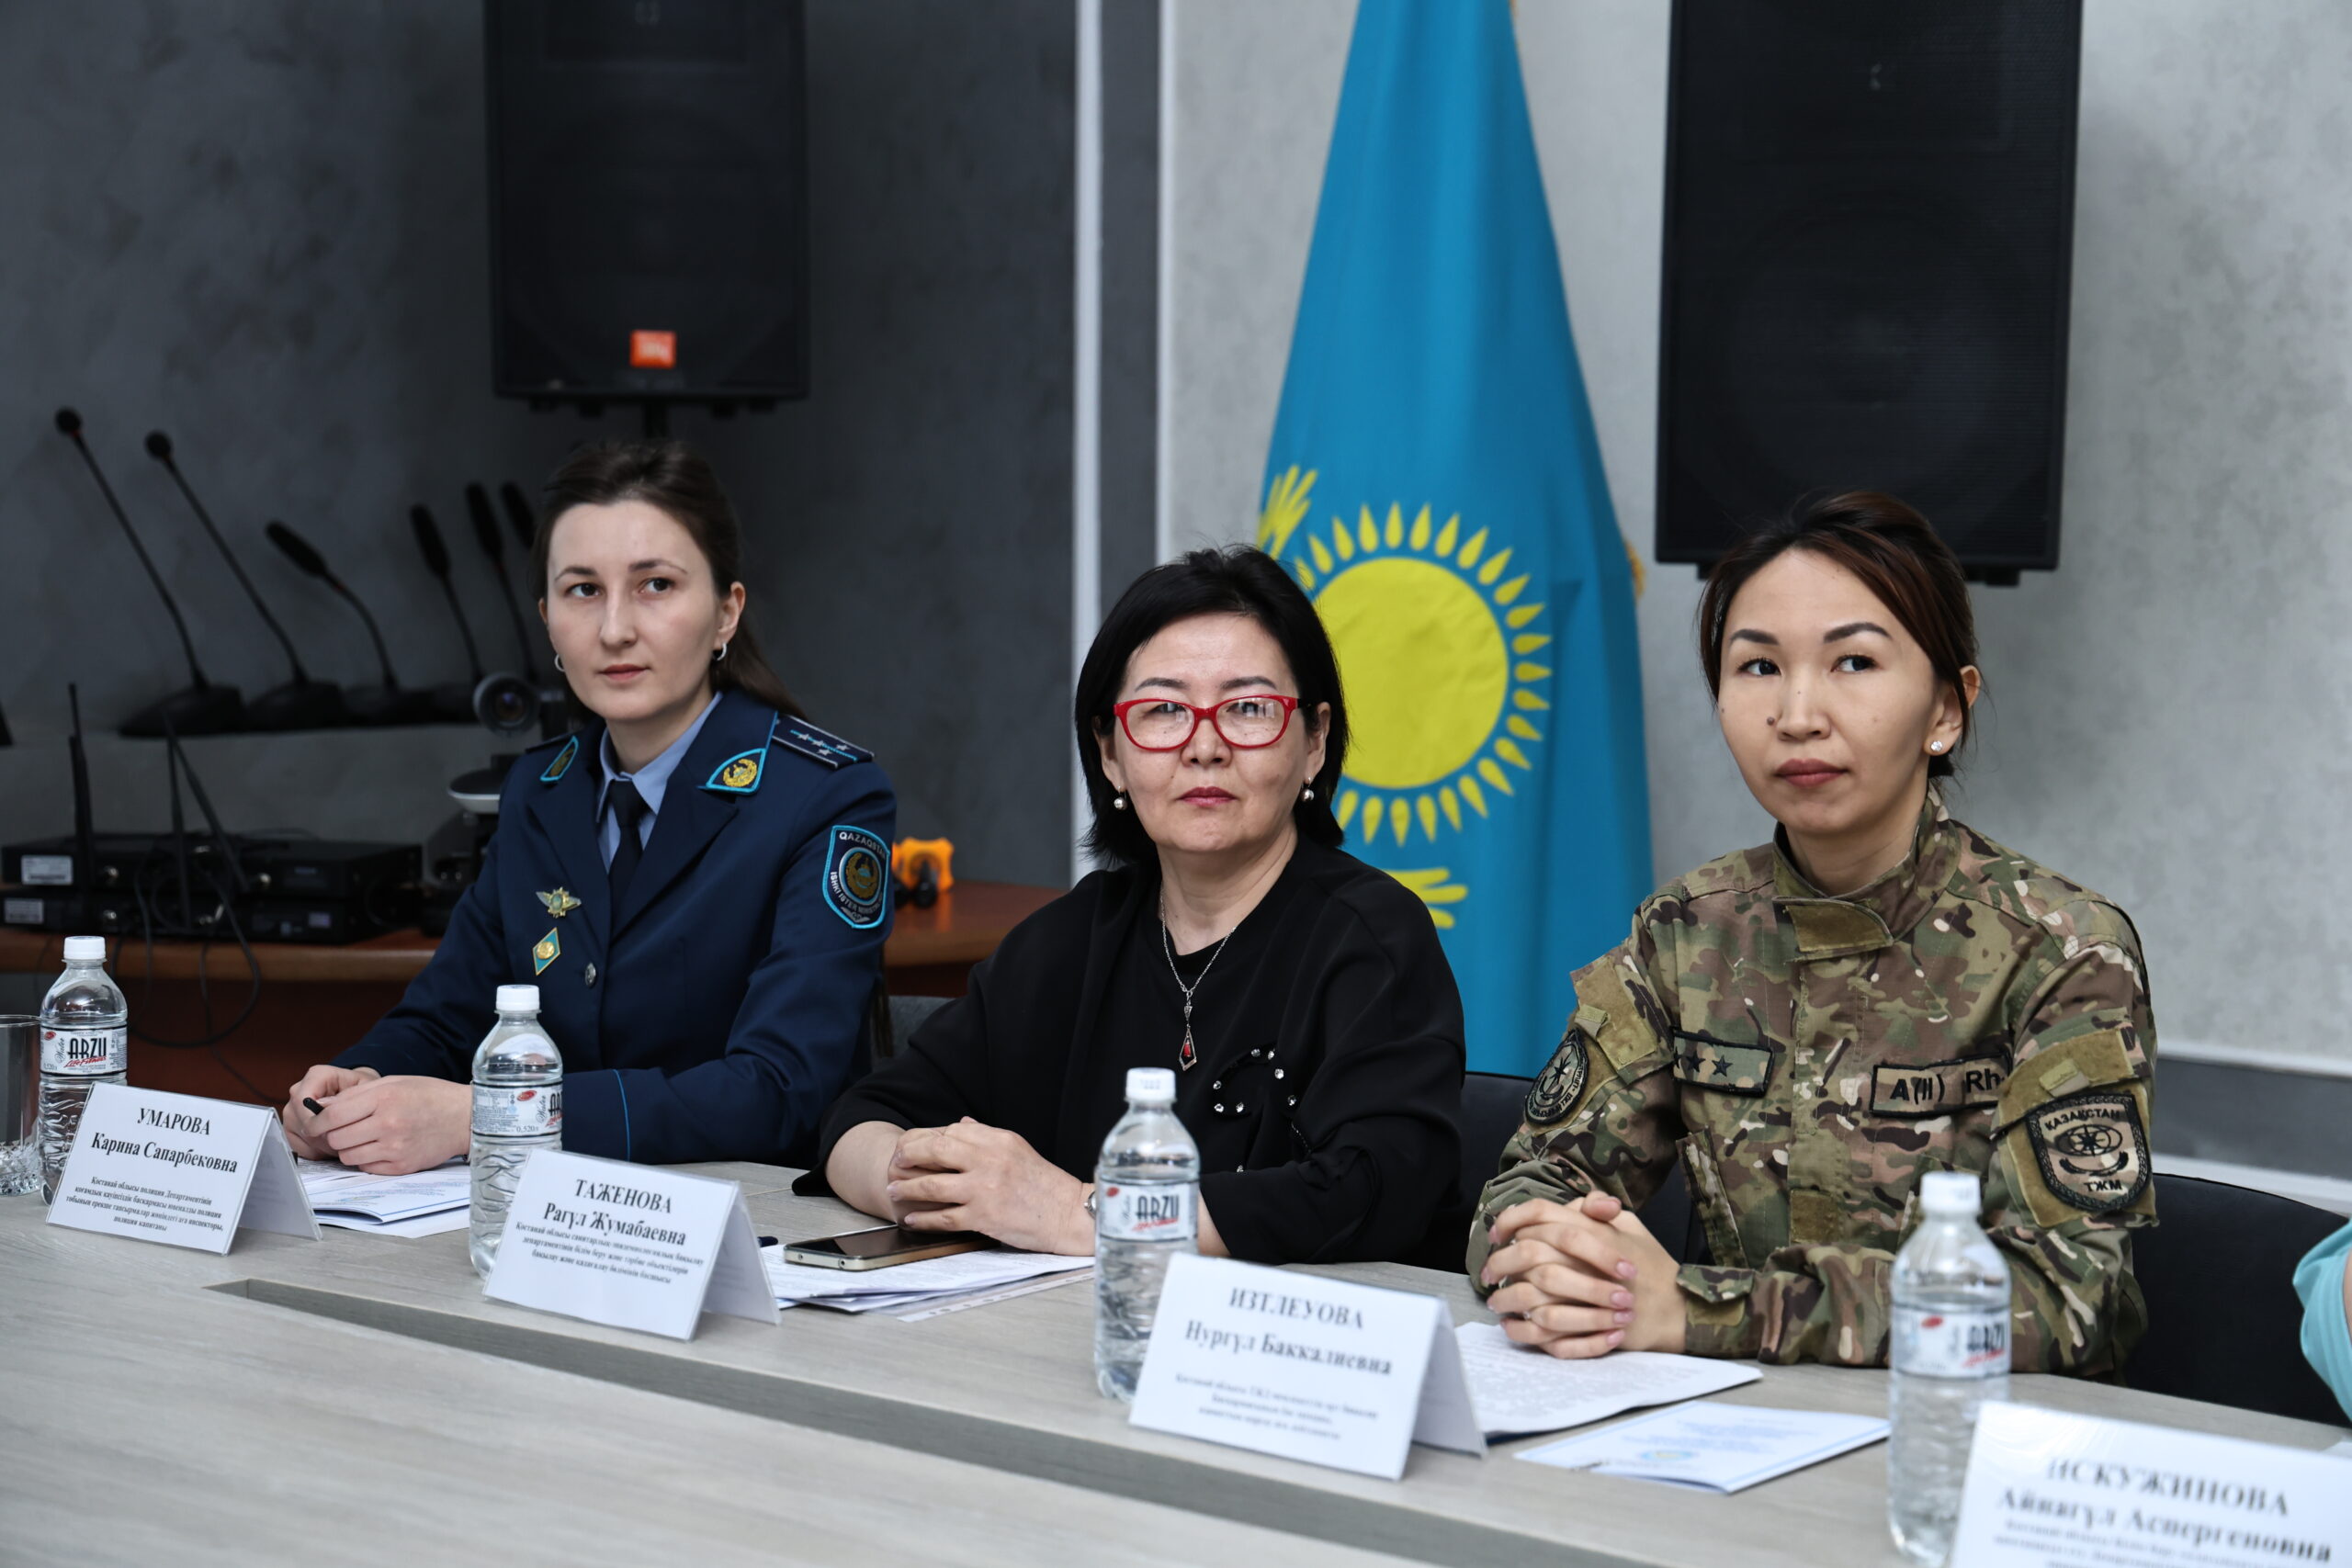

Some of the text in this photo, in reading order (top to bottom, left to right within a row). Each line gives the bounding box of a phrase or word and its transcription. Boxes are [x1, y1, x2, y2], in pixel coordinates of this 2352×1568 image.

[67, 1037, 107, 1059] ARZU
[137, 1107, 210, 1136] УМАРОВА
[91, 1132, 239, 1174] Карина Сапарбековна
[575, 1179, 672, 1213] ТАЖЕНОВА
[2083, 1179, 2122, 1192] ТЖМ
[589, 1211, 687, 1247] Жумабаевна
[1228, 1286, 1365, 1330] ИЗТЛЕУОВА
[1261, 1332, 1394, 1376] Баккалиевна
